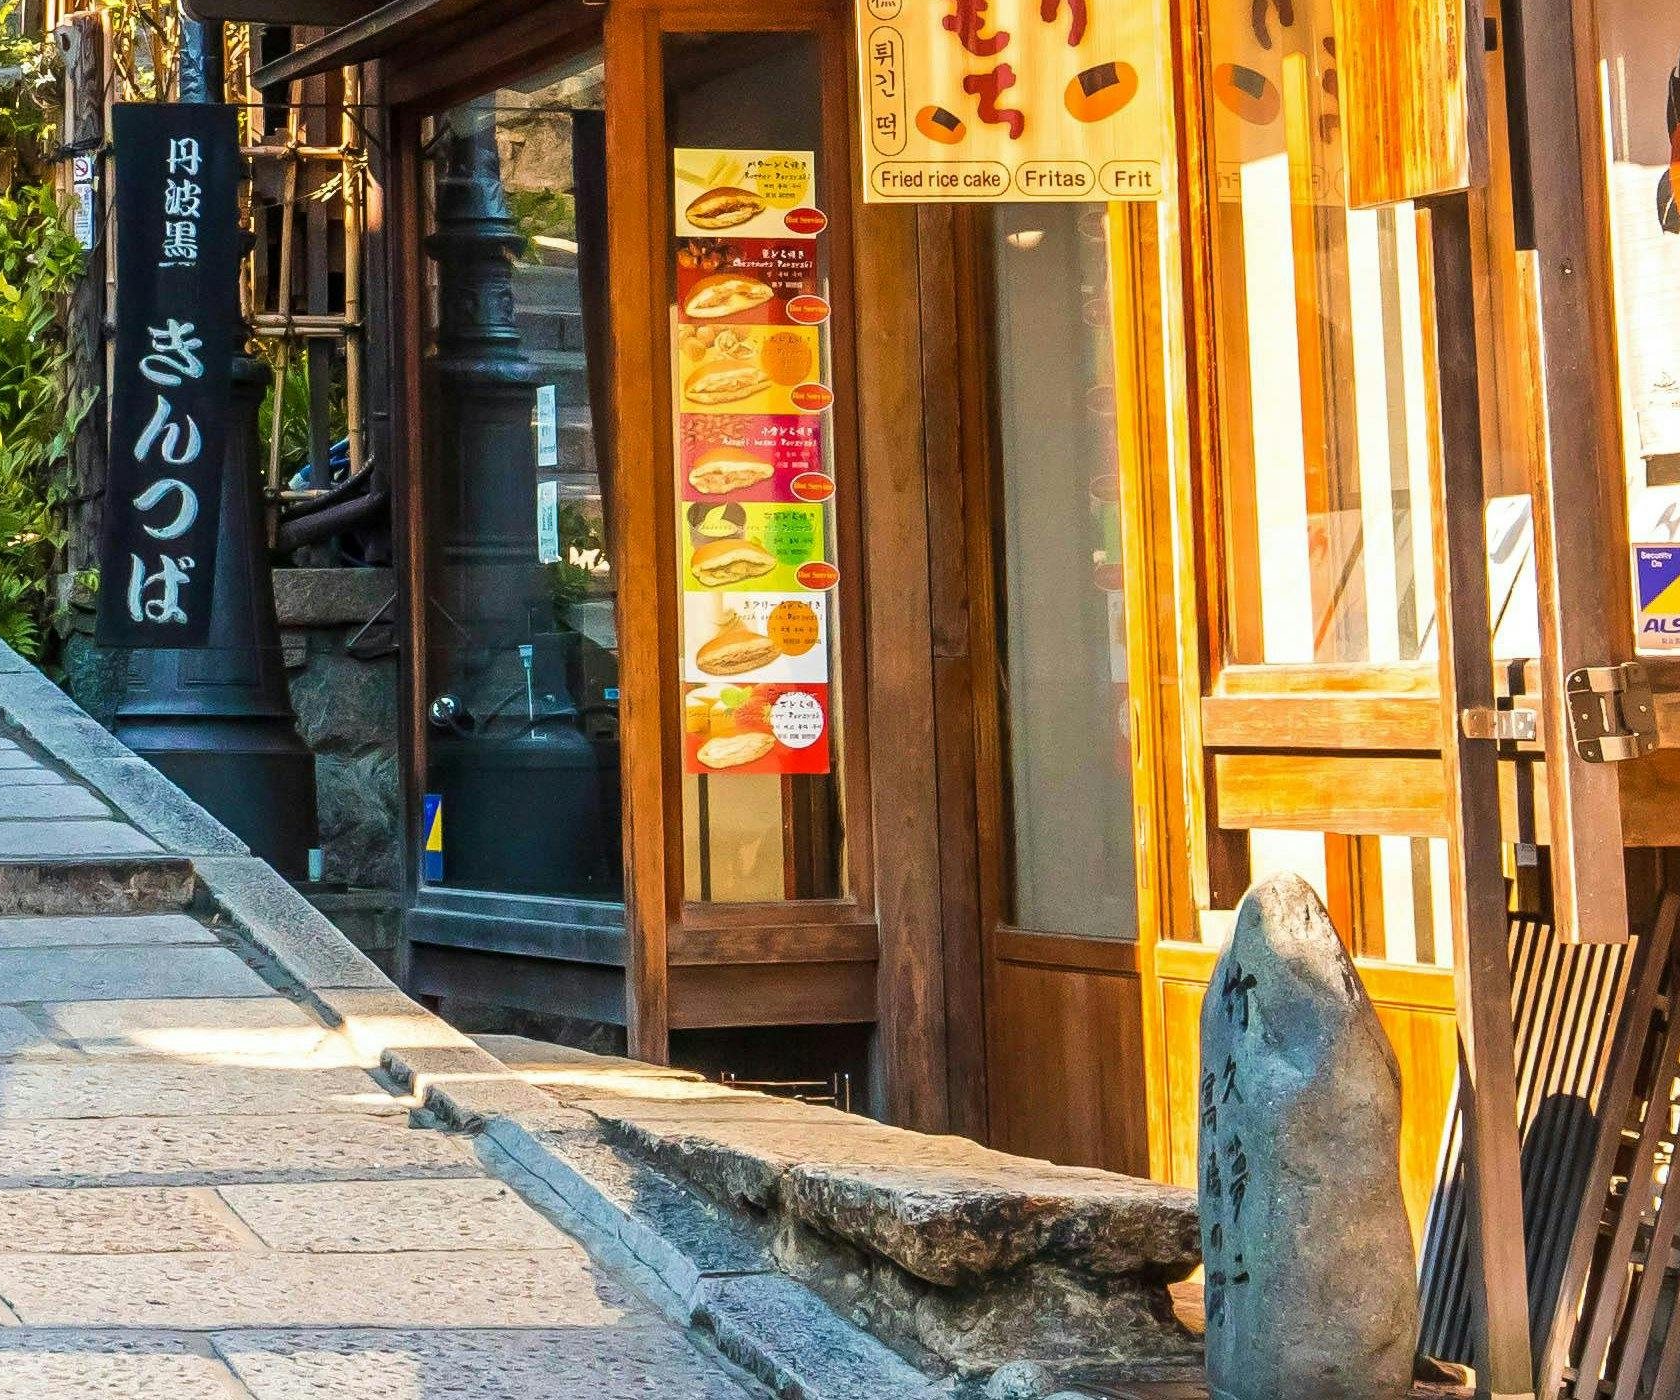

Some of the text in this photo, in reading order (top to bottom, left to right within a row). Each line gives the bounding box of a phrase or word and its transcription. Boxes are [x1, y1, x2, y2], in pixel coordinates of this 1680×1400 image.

[873, 40, 897, 142] 튀긴 떡
[880, 169, 1002, 189] Fried rice cake
[1024, 169, 1086, 189] Fritas
[1114, 169, 1153, 189] Frit
[126, 136, 205, 627] 丹波黒 きんつば
[1640, 551, 1673, 560] Security
[1651, 560, 1663, 568] On
